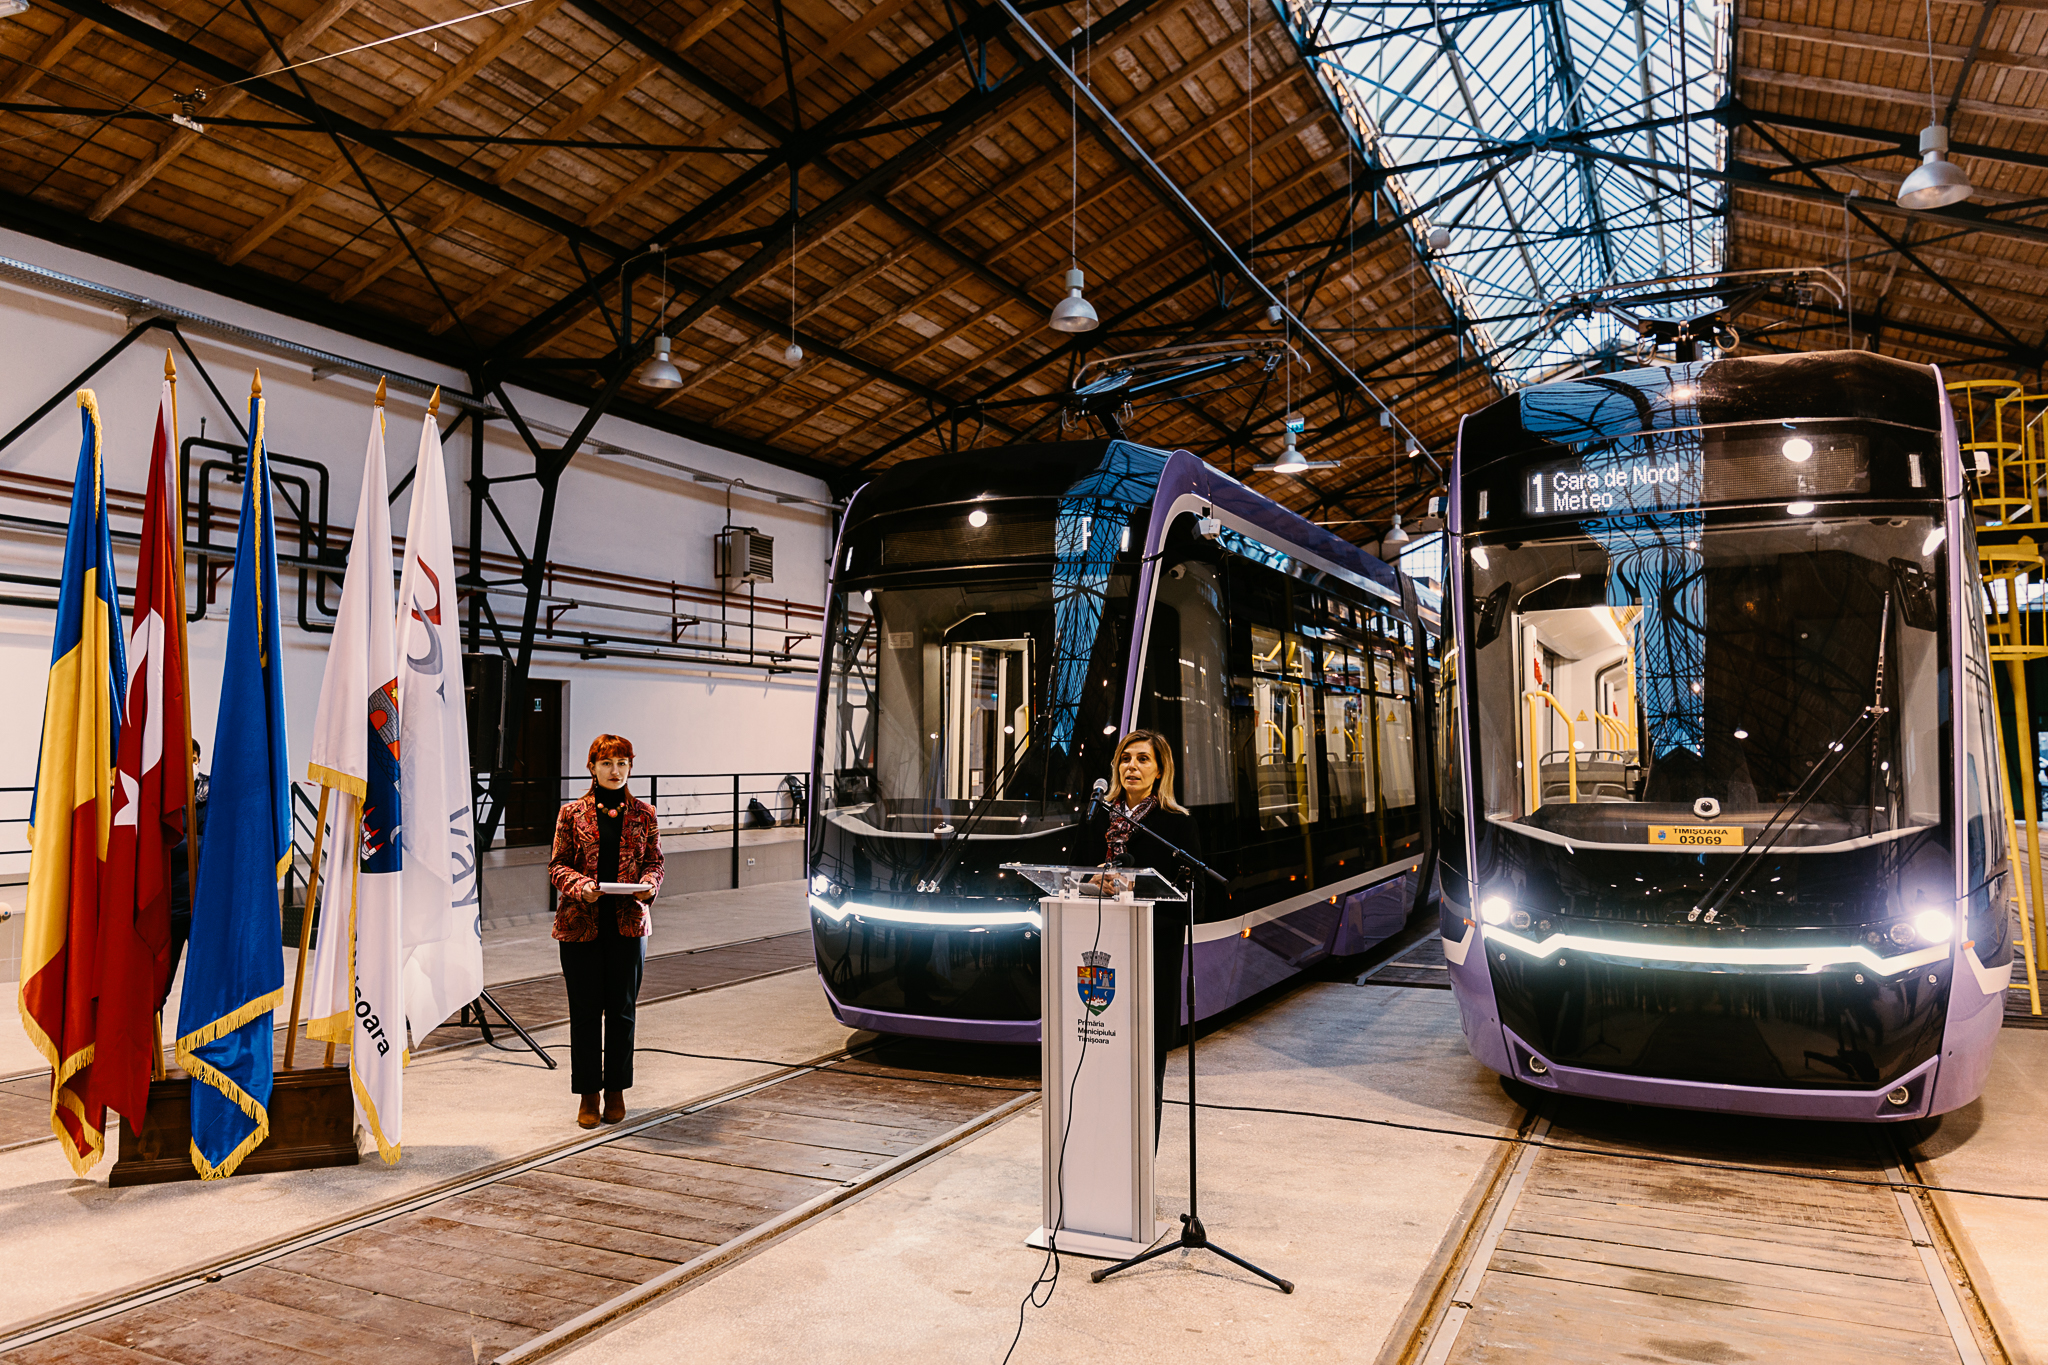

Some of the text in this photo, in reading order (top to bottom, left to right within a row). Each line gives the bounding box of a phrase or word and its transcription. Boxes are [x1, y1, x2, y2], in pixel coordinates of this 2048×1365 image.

[1553, 462, 1679, 491] Gara de Nord
[1533, 473, 1545, 513] 1
[1553, 490, 1613, 512] Meteo
[1680, 835, 1721, 844] 03069
[1078, 1019, 1104, 1027] Prmăria
